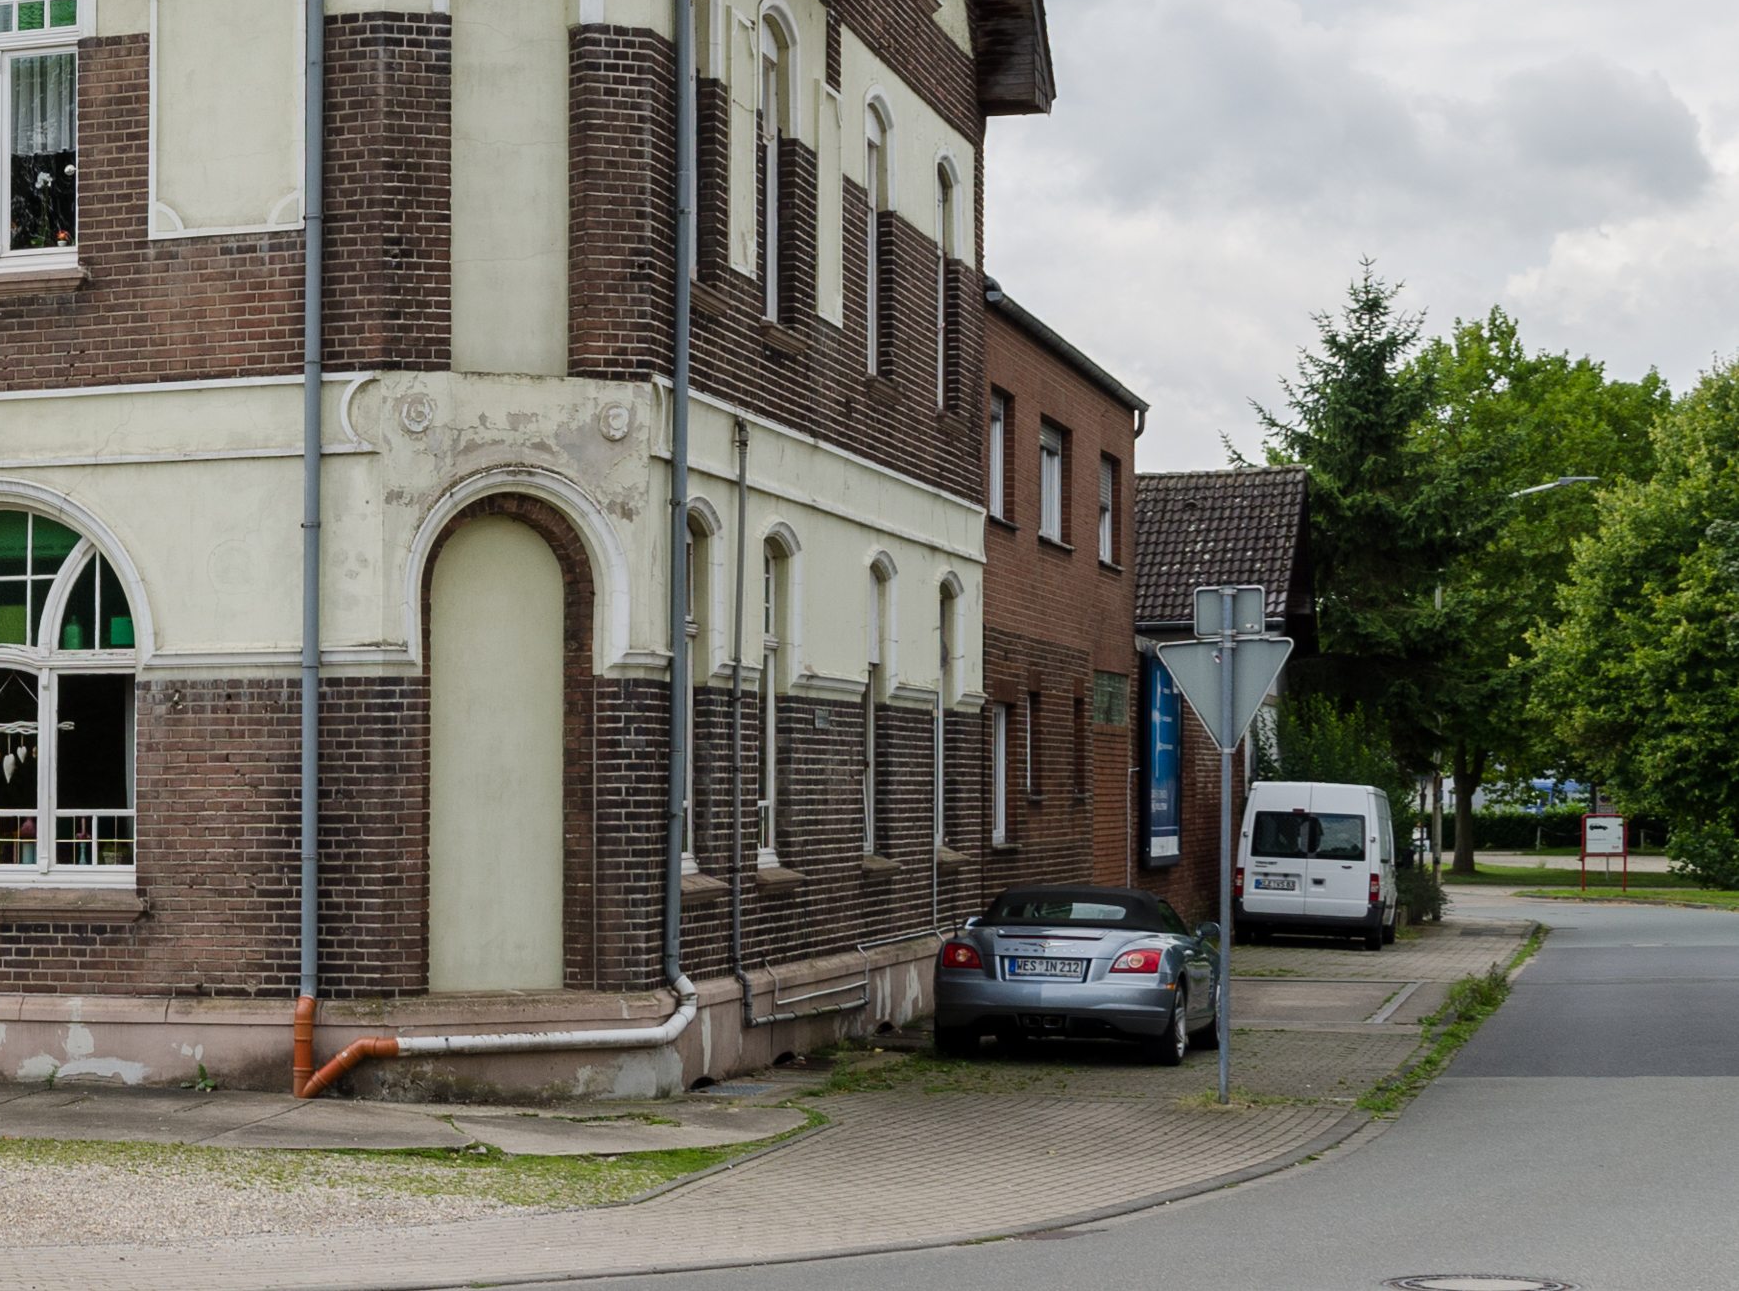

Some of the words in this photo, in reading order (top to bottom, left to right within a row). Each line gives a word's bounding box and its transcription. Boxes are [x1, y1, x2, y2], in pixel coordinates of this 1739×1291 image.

[1016, 960, 1037, 971] WES
[1044, 961, 1058, 972] IN
[1059, 961, 1080, 973] 212
